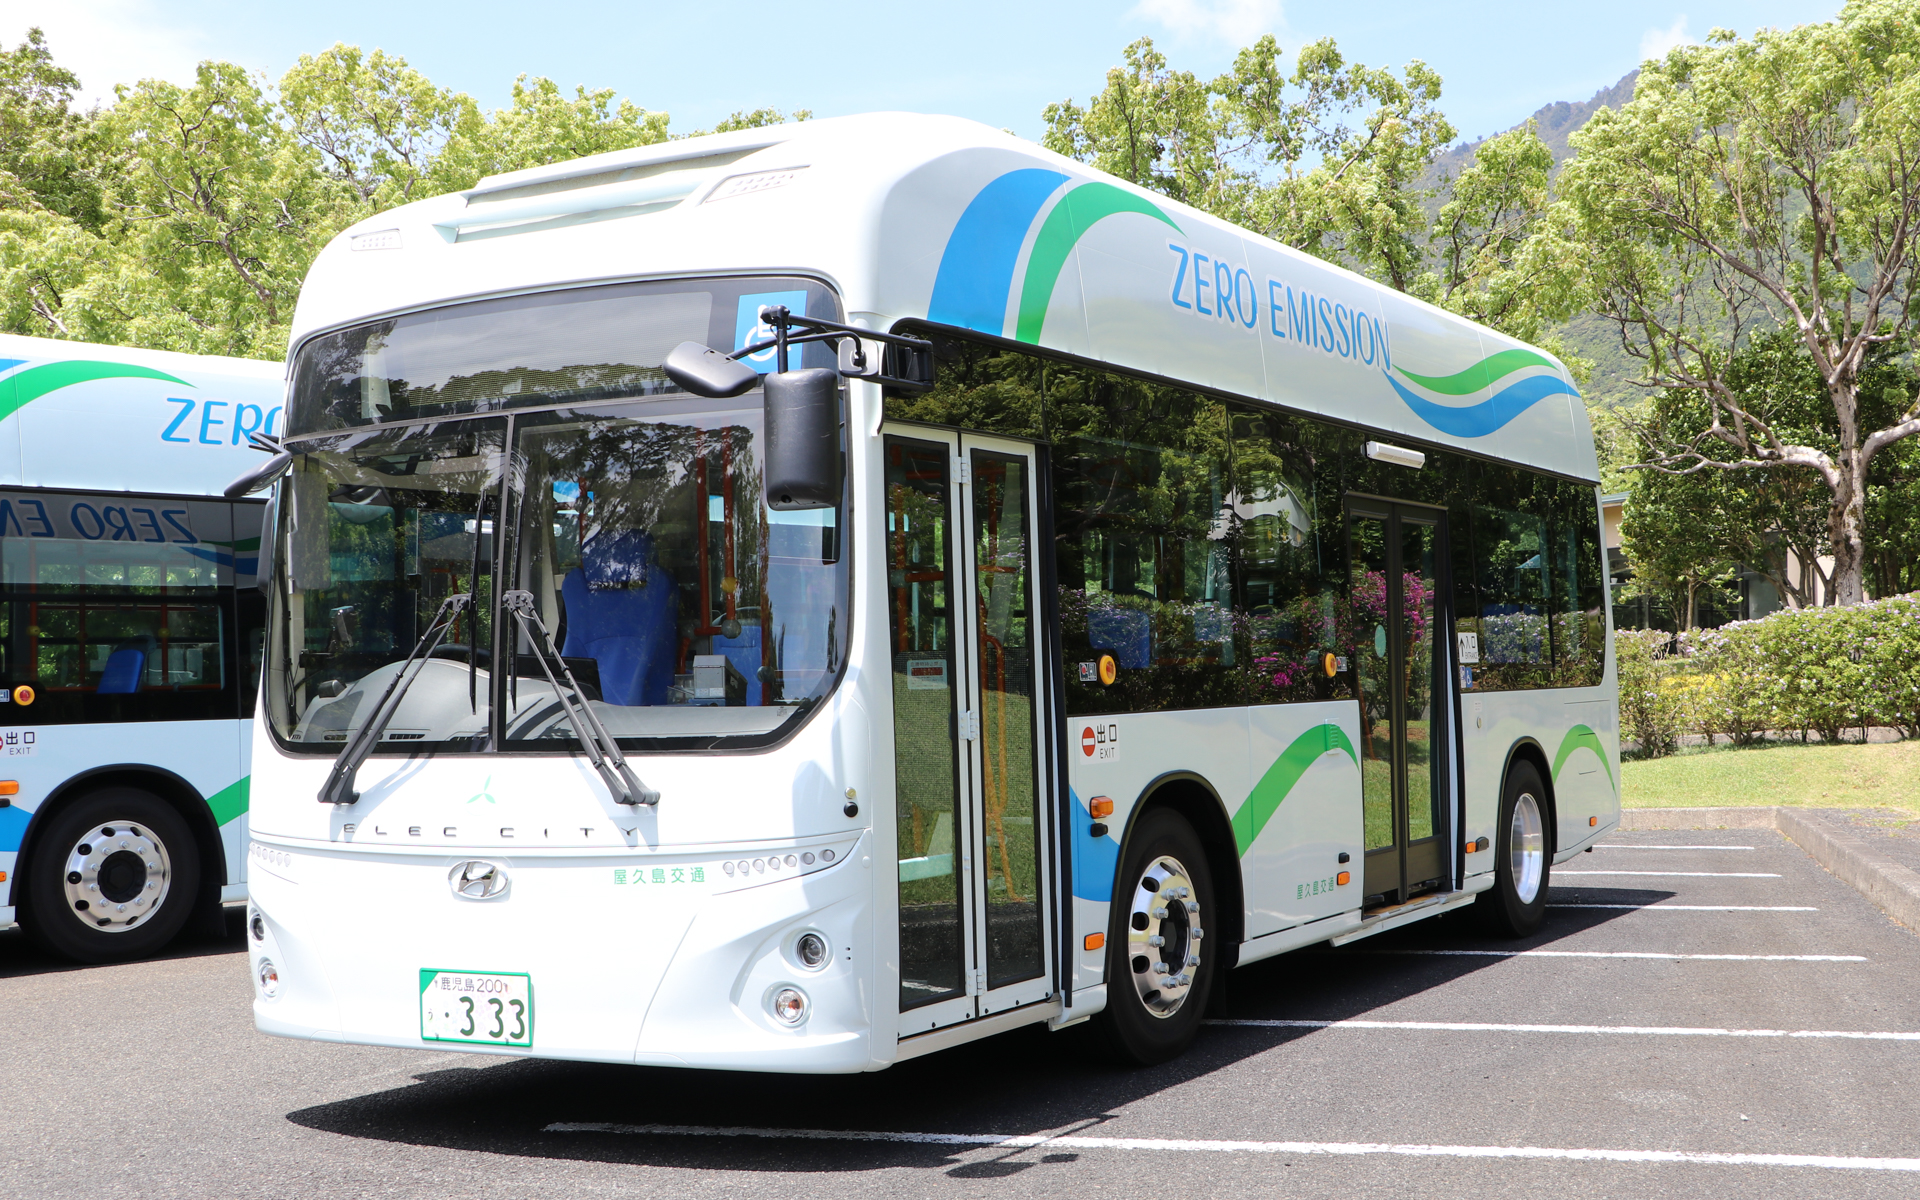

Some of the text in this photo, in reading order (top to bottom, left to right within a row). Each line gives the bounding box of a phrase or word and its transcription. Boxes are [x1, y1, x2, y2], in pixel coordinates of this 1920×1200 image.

[1168, 243, 1391, 371] ZERO EMISSION
[1465, 635, 1476, 649] 入口
[6, 731, 35, 745] 出口
[1096, 724, 1117, 743] 出口
[9, 747, 31, 755] EXIT
[1100, 747, 1115, 759] EXIT
[343, 822, 638, 839] ELEC CITY
[613, 866, 706, 885] 屋久島交通
